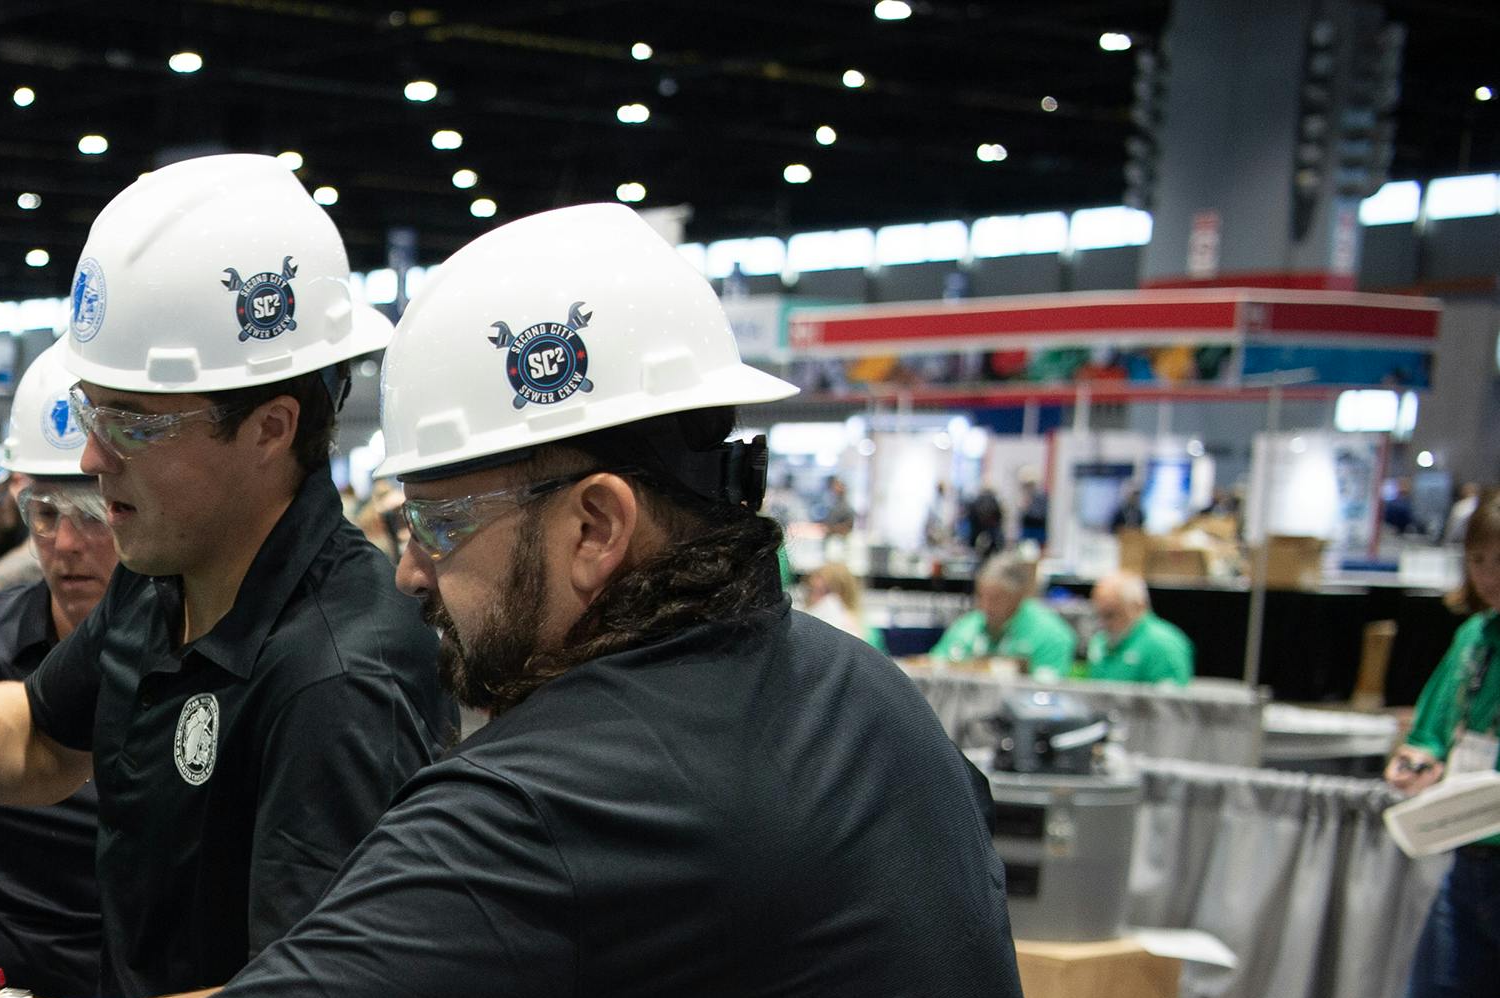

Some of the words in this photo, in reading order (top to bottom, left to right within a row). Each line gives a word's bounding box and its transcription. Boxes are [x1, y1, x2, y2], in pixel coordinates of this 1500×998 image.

[240, 274, 268, 297] SECOND
[269, 274, 287, 288] CITY
[244, 323, 270, 338] SEWER
[273, 314, 292, 336] CREW
[511, 324, 547, 354] SECOND
[549, 323, 575, 340] CITY
[518, 384, 555, 403] SEWER
[558, 371, 584, 399] CREW
